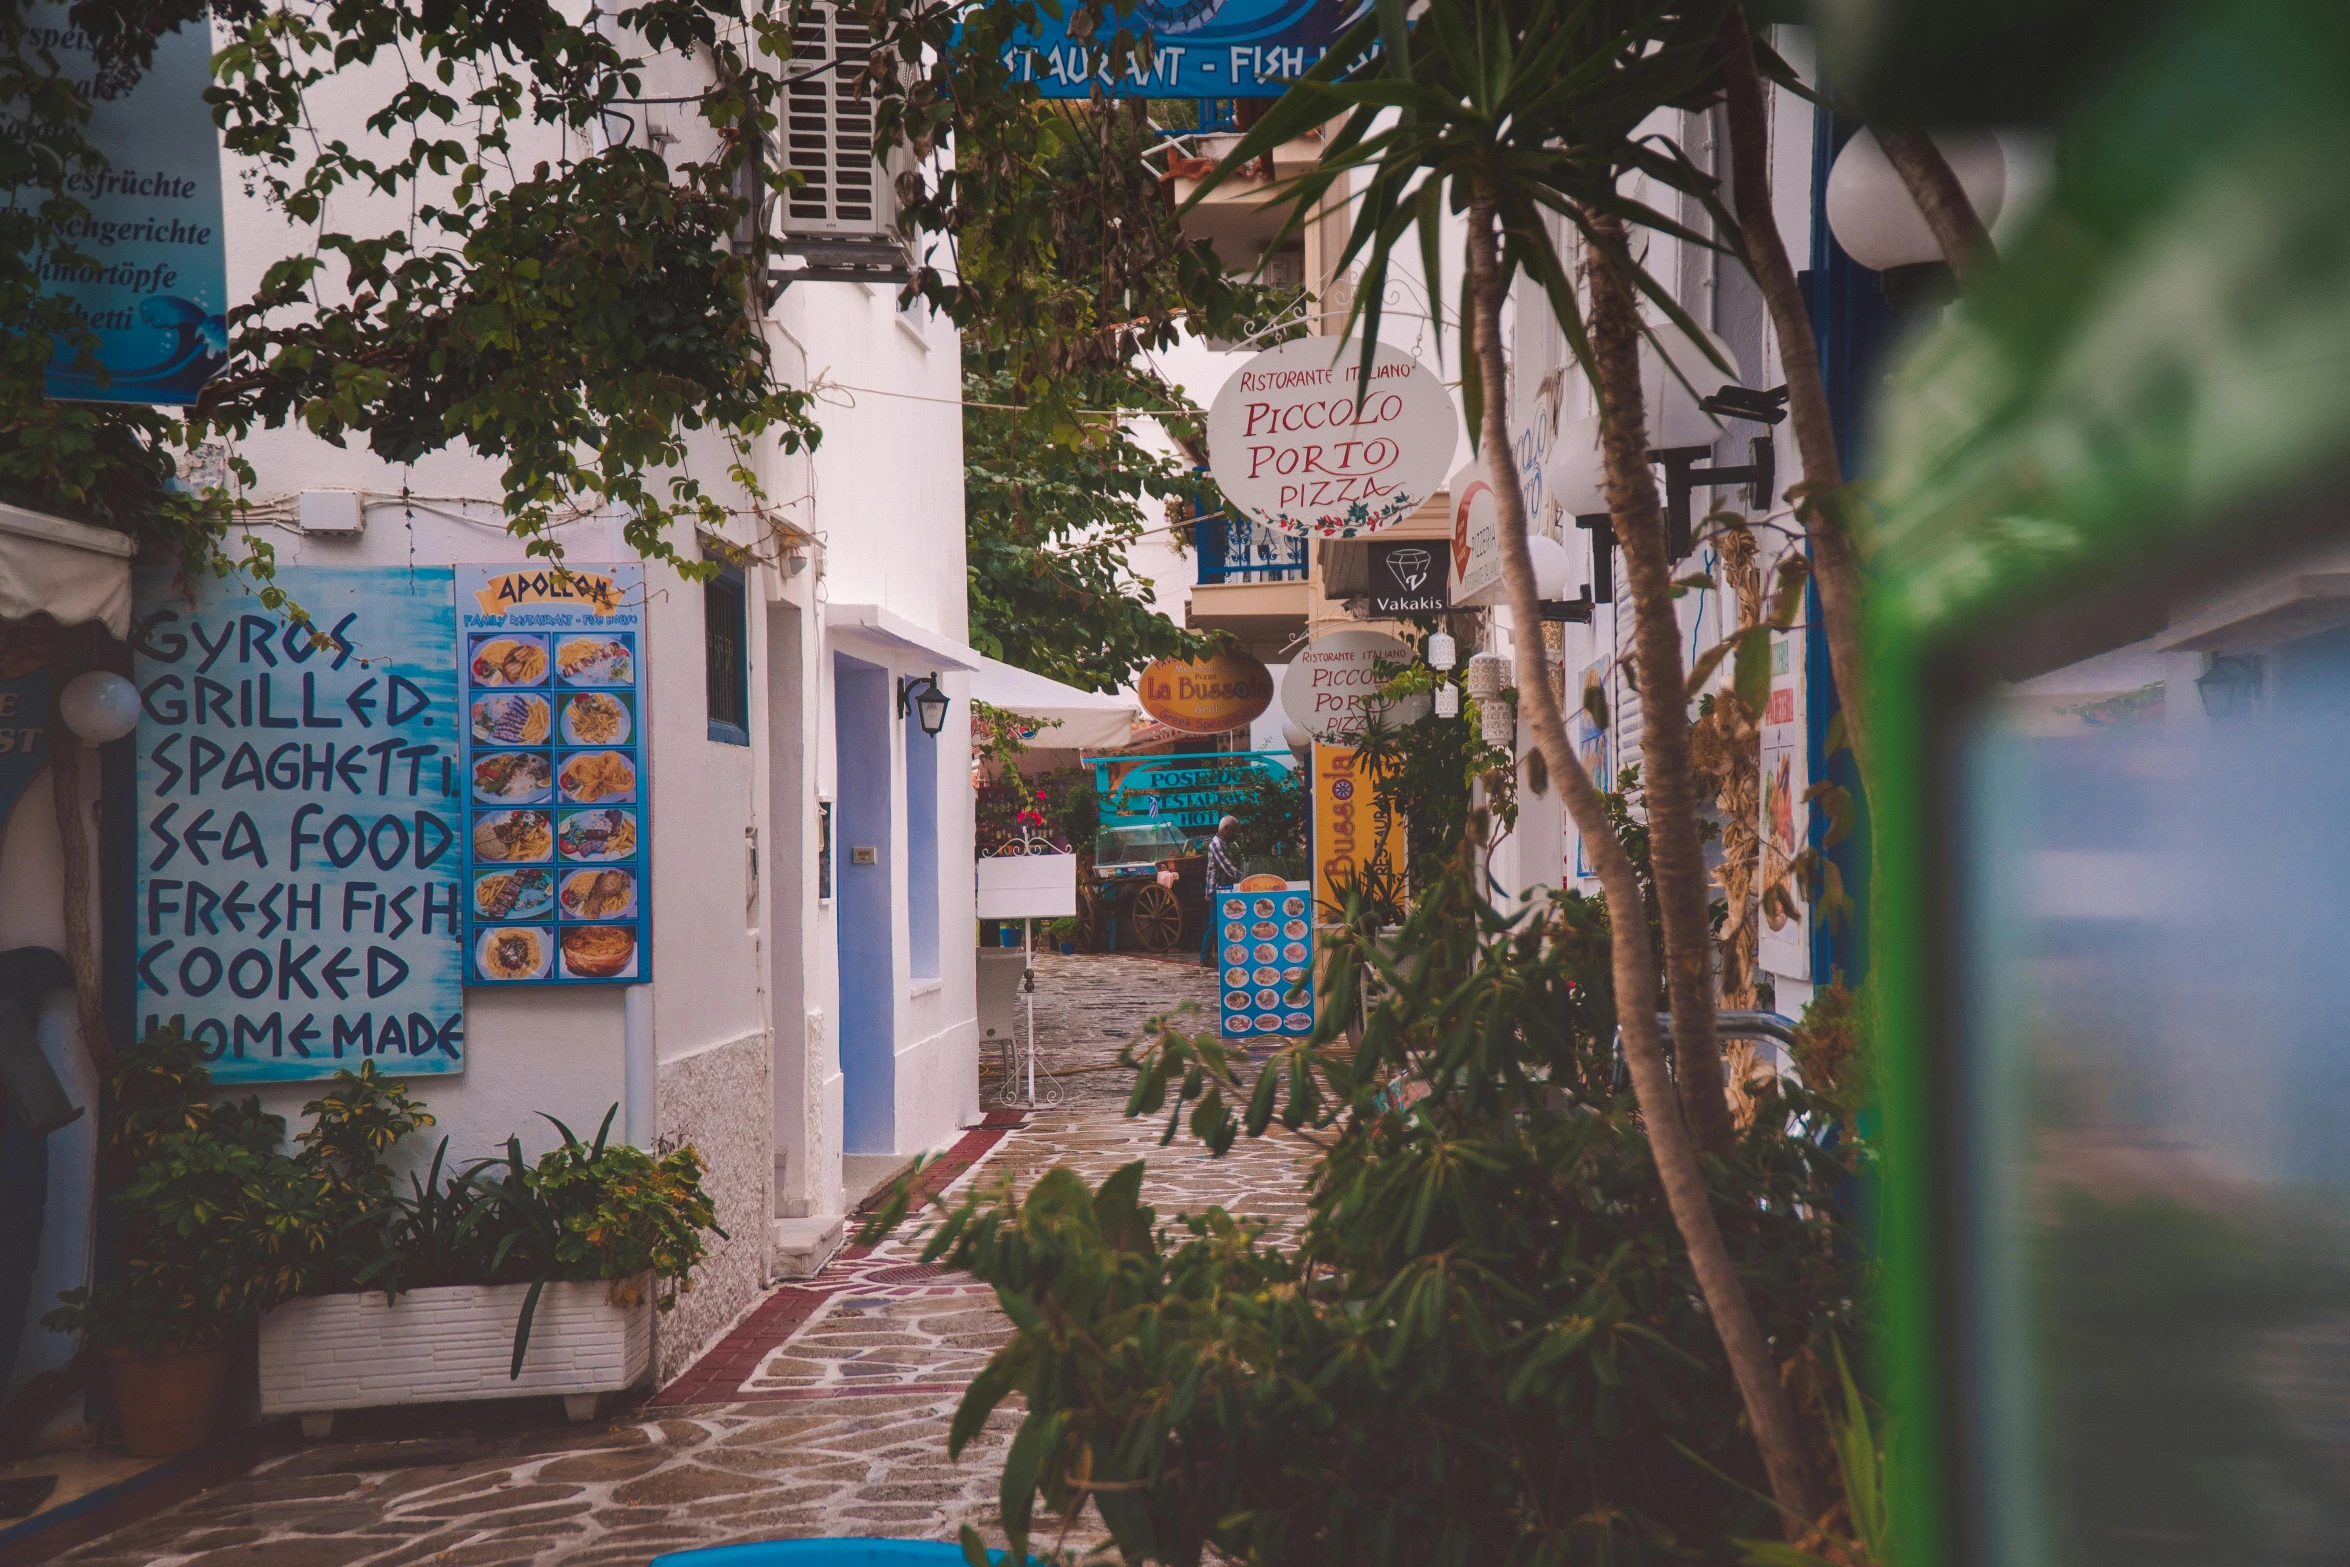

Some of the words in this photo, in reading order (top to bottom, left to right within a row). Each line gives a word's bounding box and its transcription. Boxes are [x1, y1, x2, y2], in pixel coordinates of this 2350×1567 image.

[1001, 43, 1187, 87] STAURANT
[1229, 44, 1304, 85] FISH
[28, 252, 177, 294] hmortöpfe
[1240, 368, 1333, 392] RISTORANTE
[1346, 363, 1411, 382] ITLIANO
[1242, 390, 1403, 437] PICCOLO
[1246, 437, 1400, 479] PORTO
[1280, 476, 1406, 508] PIZZA
[463, 613, 507, 628] FAMILY
[509, 613, 574, 627] RESTAURANT
[582, 614, 604, 626] FISH
[606, 614, 638, 626] HOUSE
[1376, 595, 1443, 613] Vakakis
[1302, 651, 1354, 663] RISTORANTE
[1363, 649, 1406, 660] ITALIANO
[1147, 675, 1171, 700] La
[1178, 674, 1269, 700] Bussola
[1312, 668, 1391, 687] PICCOL
[139, 671, 434, 728] GRILLED.
[1194, 704, 1219, 714] Grill
[1159, 709, 1192, 728] Greek
[1322, 754, 1356, 877] Bussola
[149, 802, 268, 872] SEA
[290, 802, 453, 872] FOOD
[147, 879, 321, 939] FRESH
[137, 938, 410, 1001] COOKED
